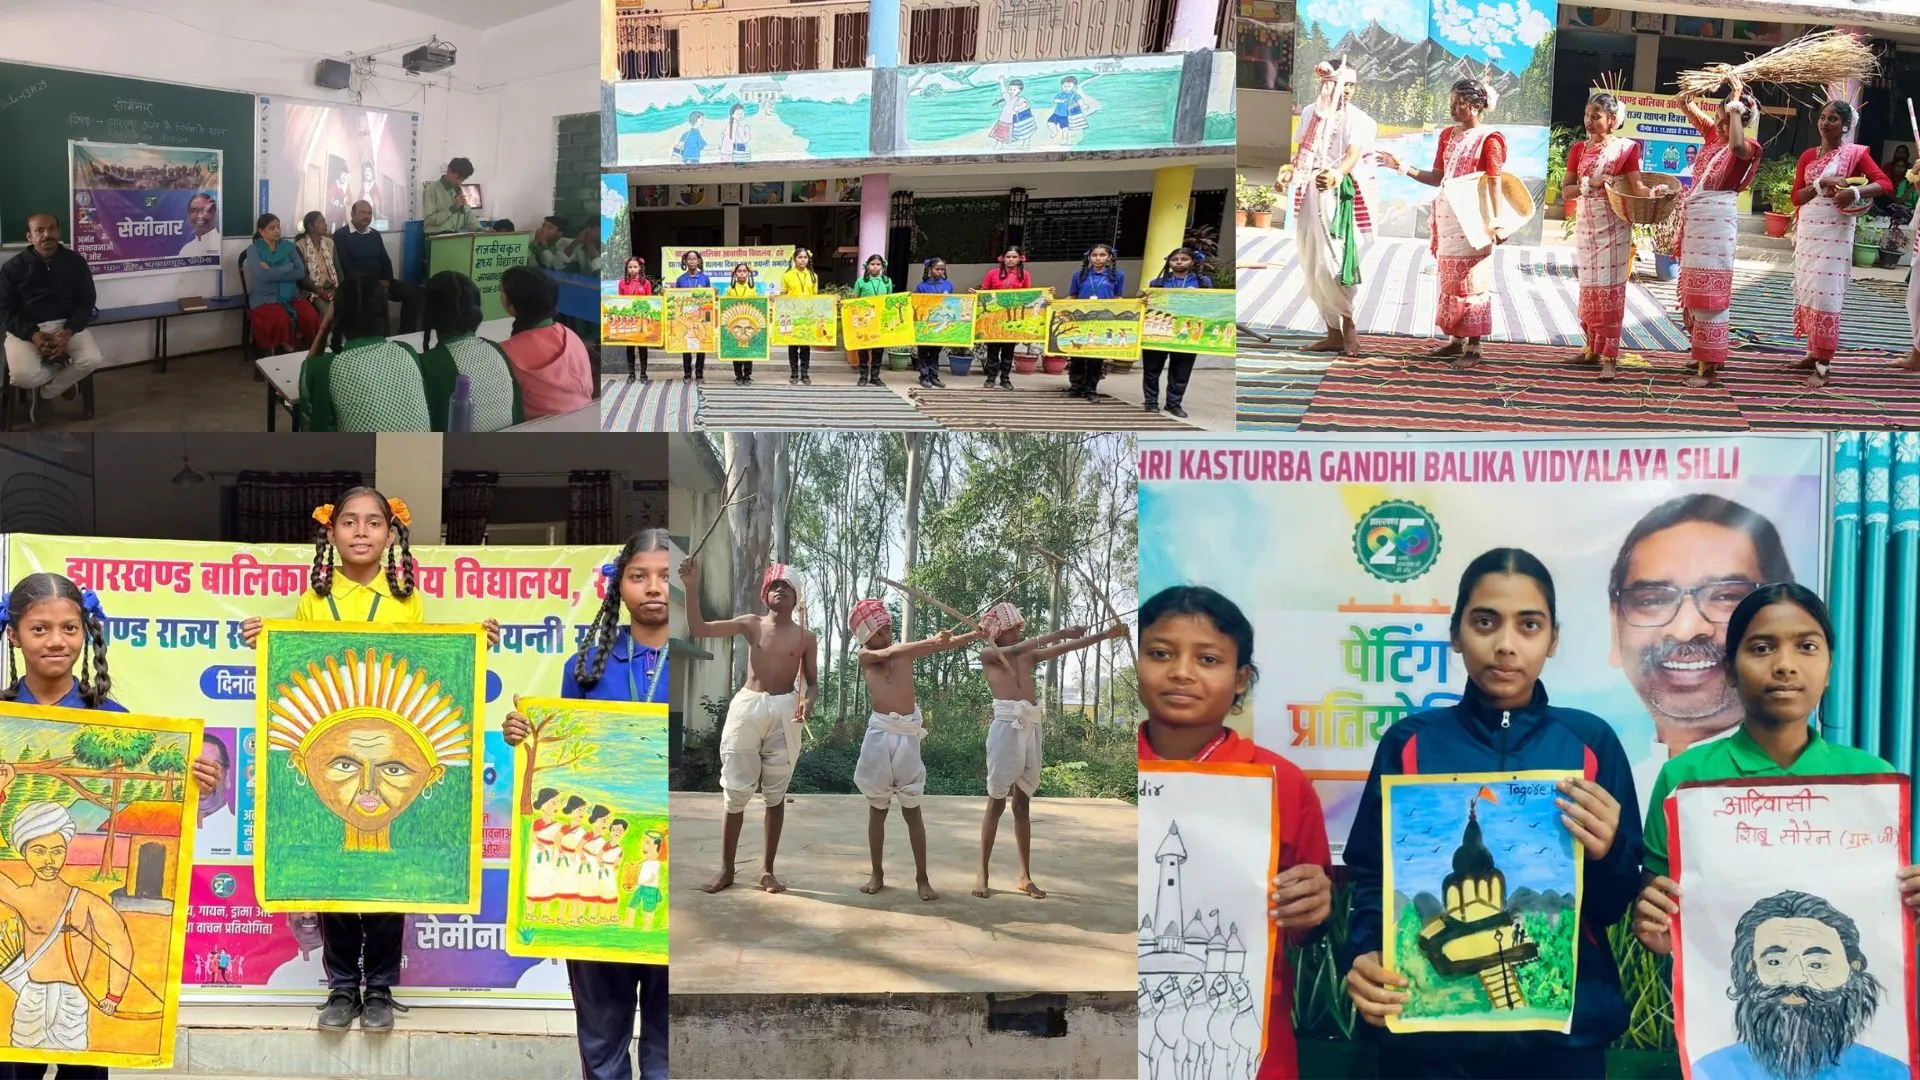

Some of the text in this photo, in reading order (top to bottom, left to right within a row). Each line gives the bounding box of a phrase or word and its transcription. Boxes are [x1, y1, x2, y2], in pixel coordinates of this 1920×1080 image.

[1627, 110, 1643, 120] राज्य
[1643, 112, 1667, 121] स्थापना
[1638, 97, 1665, 108] बालिका
[116, 216, 184, 238] सेमीनार
[496, 254, 525, 268] विद्यालय
[1180, 450, 1313, 481] KASTURBA
[1319, 451, 1416, 482] GANDHI
[1424, 450, 1515, 482] BALIKA
[1522, 448, 1669, 482] VIDYALAYA
[1676, 446, 1740, 480] SILLI
[65, 553, 311, 597] झारखण्ड बालिका
[454, 556, 581, 607] विद्यालय,
[156, 618, 219, 649] राज्य
[493, 615, 566, 653] यन्ती
[1338, 623, 1452, 684] पेंटिंग
[1506, 783, 1547, 805] Tagore
[1713, 787, 1829, 816] आदिवासी
[1735, 821, 1774, 847] शिबू
[1780, 819, 1832, 847] सोरेन
[198, 905, 228, 918] गायन,
[230, 905, 253, 919] ड्रामा
[196, 922, 223, 933] वाचन
[224, 920, 273, 934] प्रतियोगिता
[414, 914, 507, 951] सेमीना
